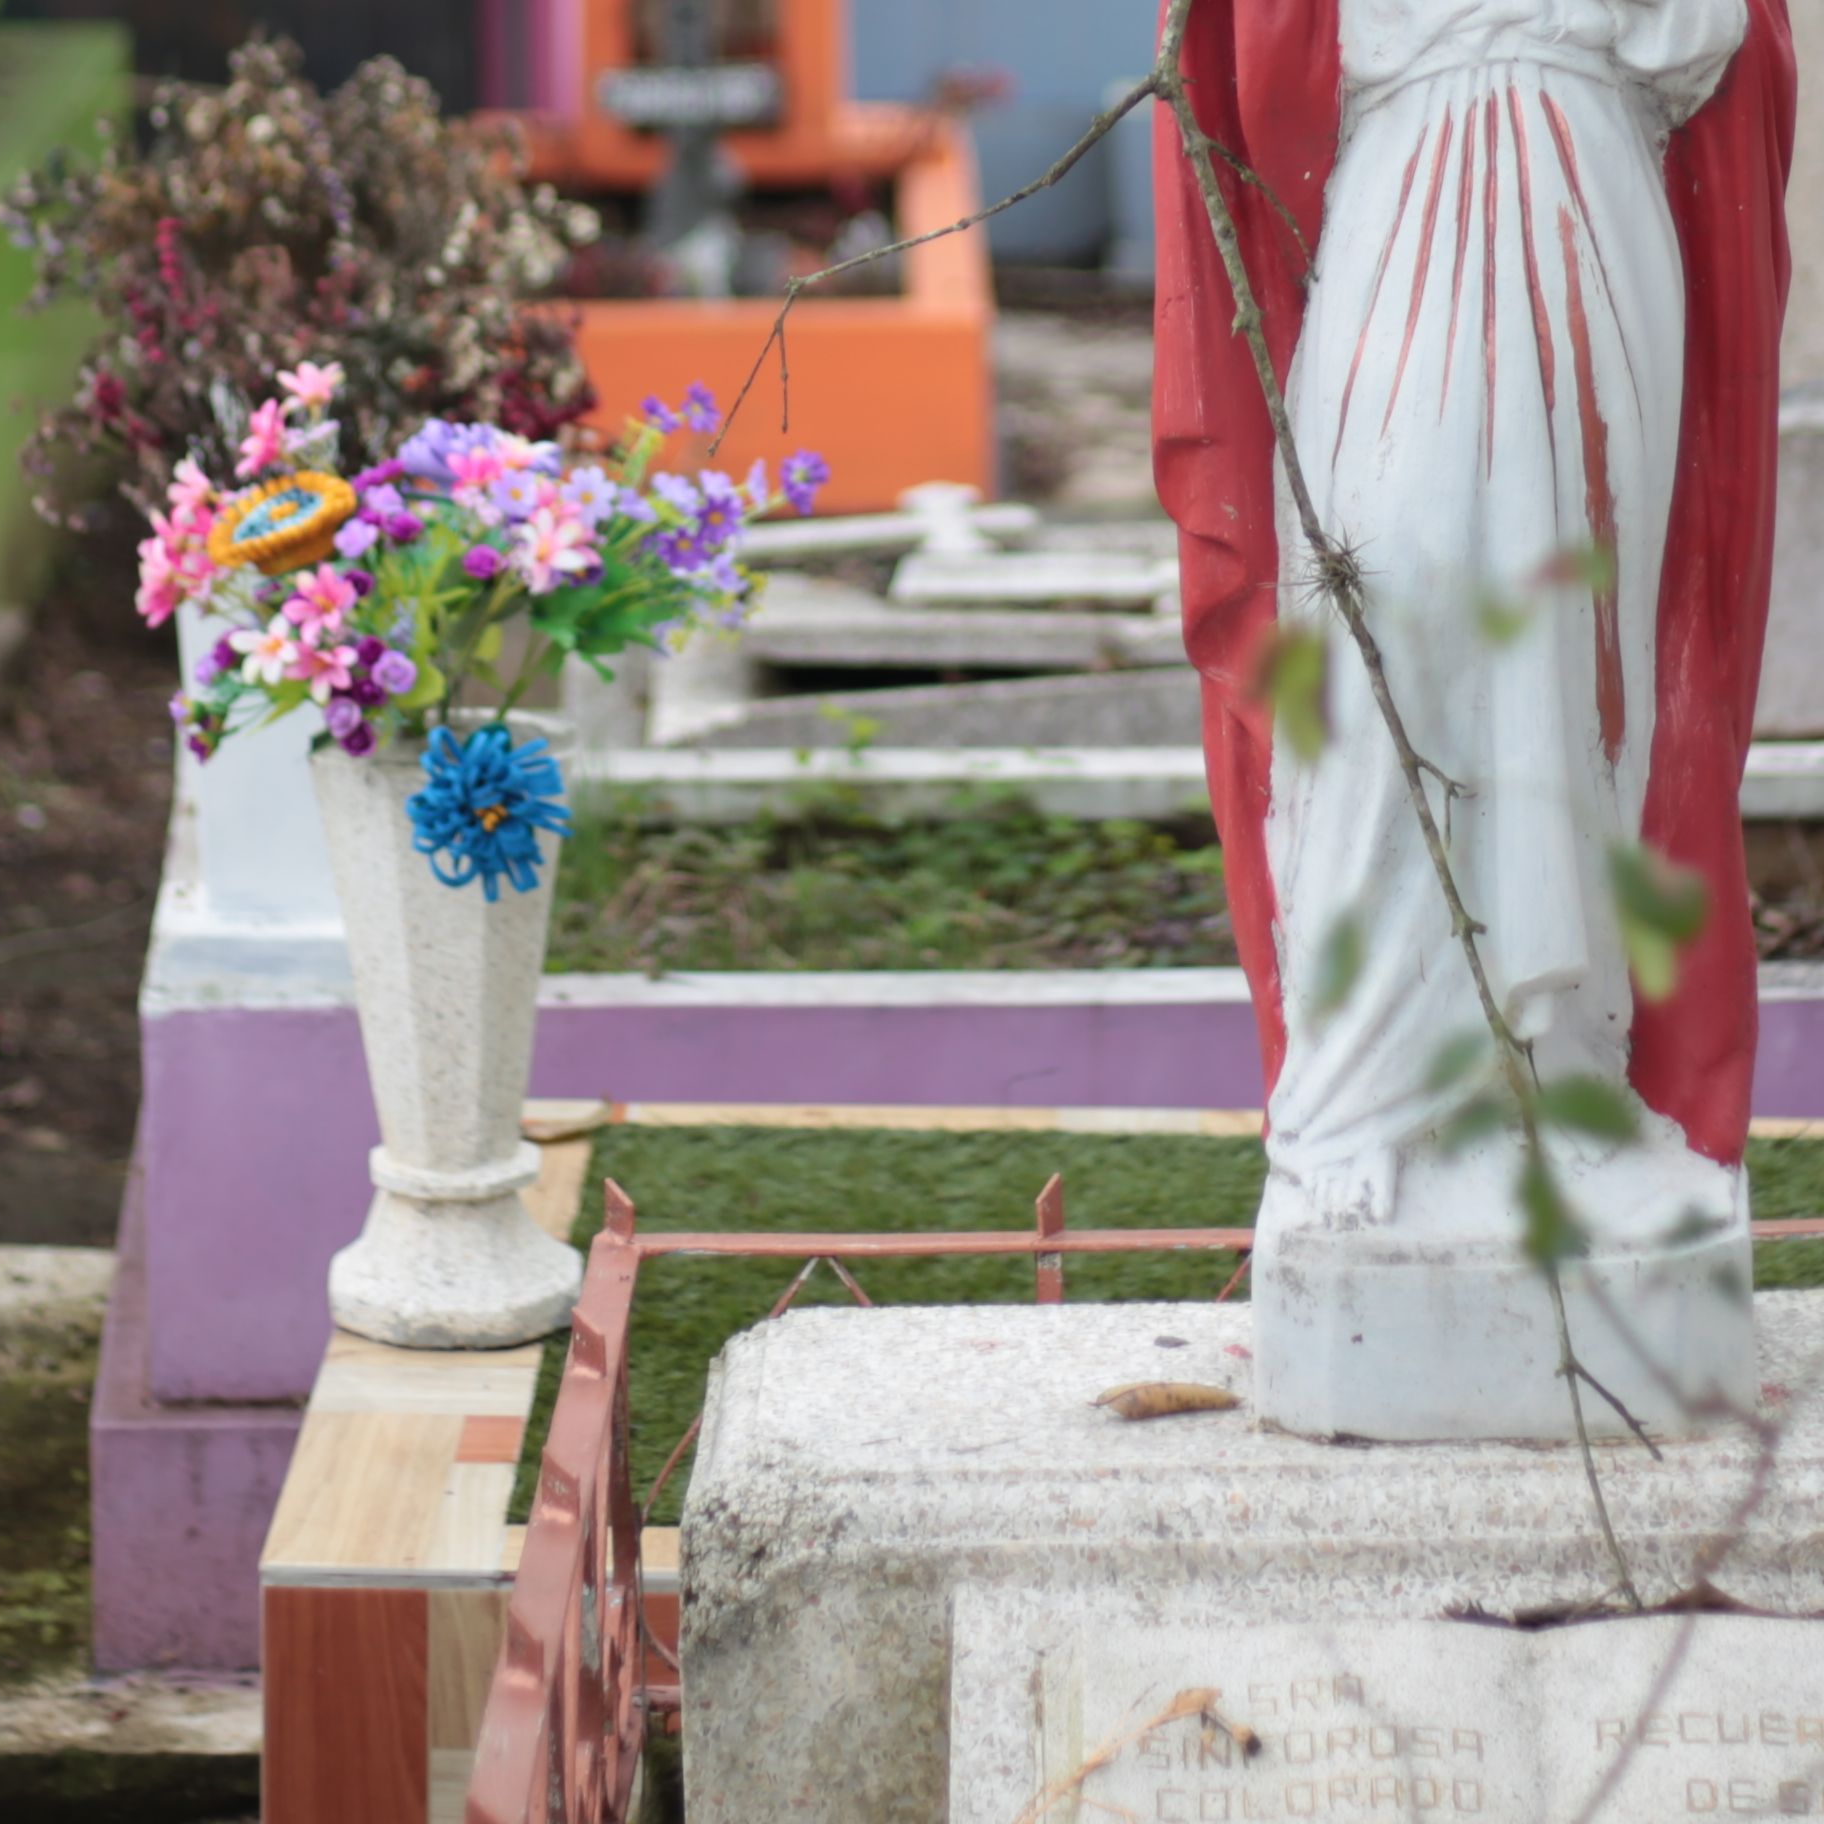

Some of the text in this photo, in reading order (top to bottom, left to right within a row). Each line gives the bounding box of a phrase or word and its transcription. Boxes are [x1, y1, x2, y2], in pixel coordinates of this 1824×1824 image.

[1248, 1674, 1365, 1716] SRA
[1156, 1775, 1483, 1822] COLORADO
[1686, 1778, 1759, 1813] DE
